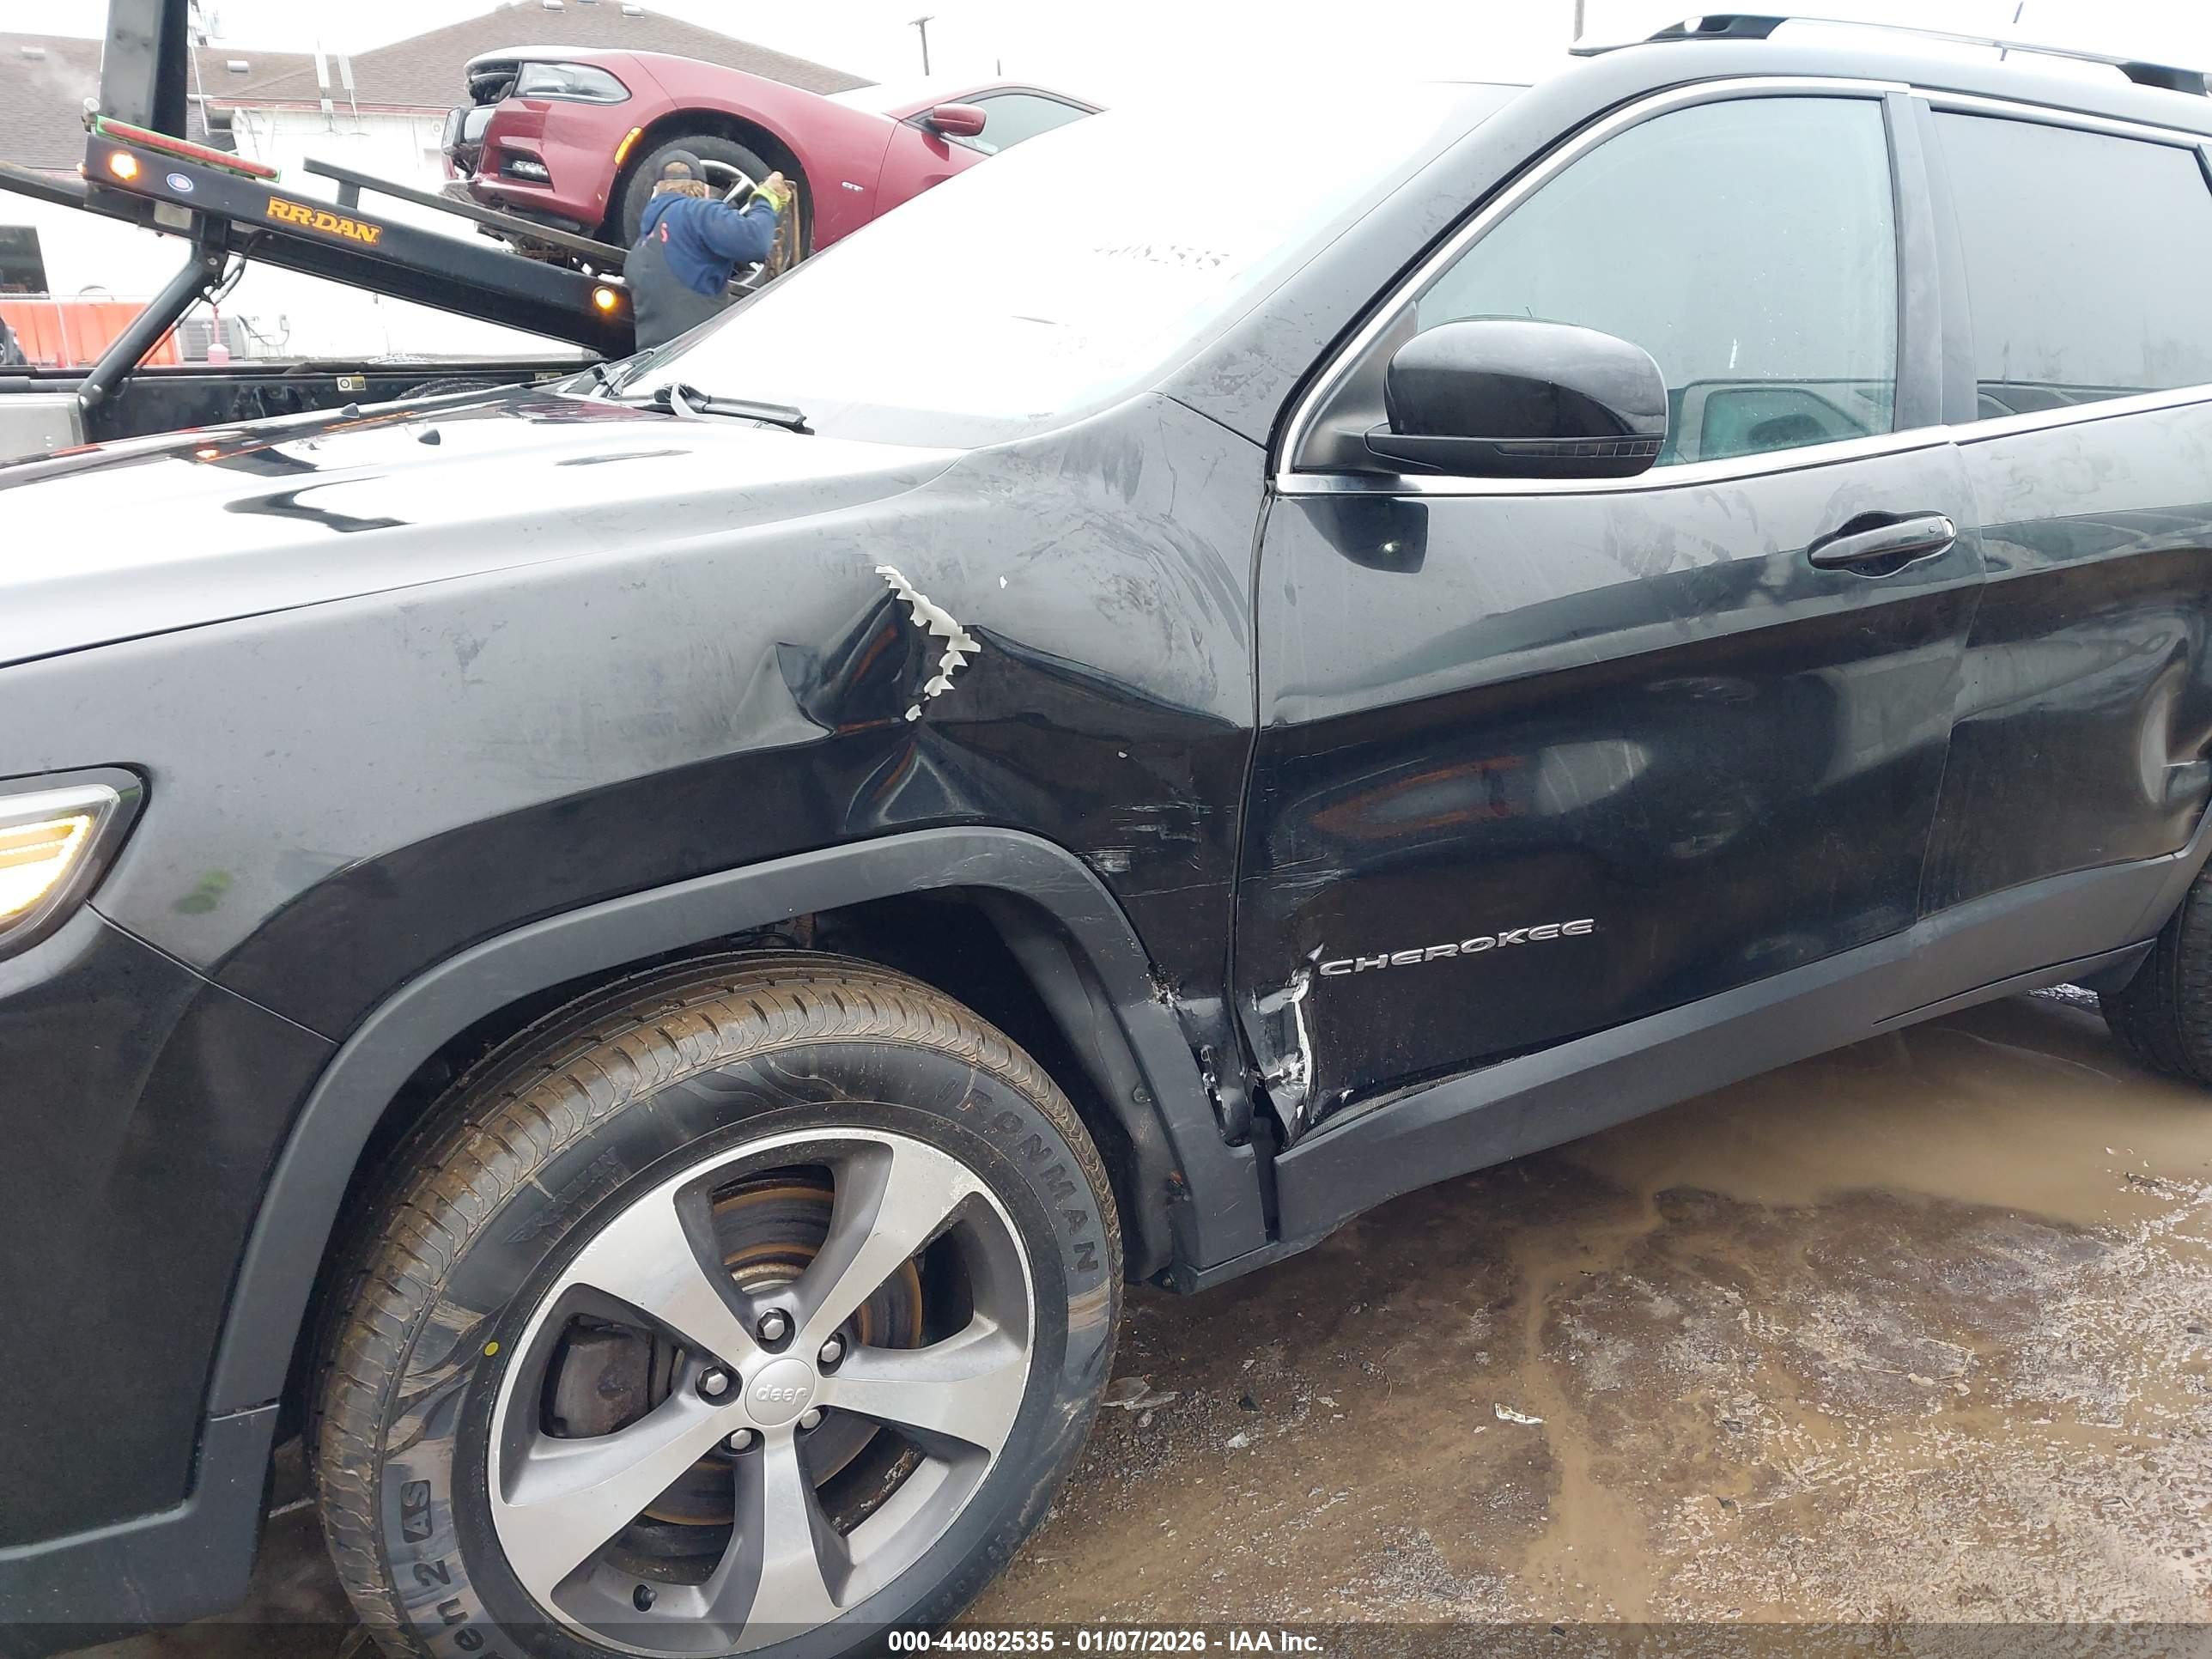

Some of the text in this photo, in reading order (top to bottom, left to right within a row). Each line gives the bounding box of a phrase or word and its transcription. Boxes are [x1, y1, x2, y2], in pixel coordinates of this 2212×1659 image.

[1319, 917, 1595, 977] CHEROKEE
[935, 1079, 1099, 1273] IRONMAN
[757, 1384, 808, 1406] Jeep
[403, 1482, 433, 1538] AS
[412, 1559, 452, 1588] 2
